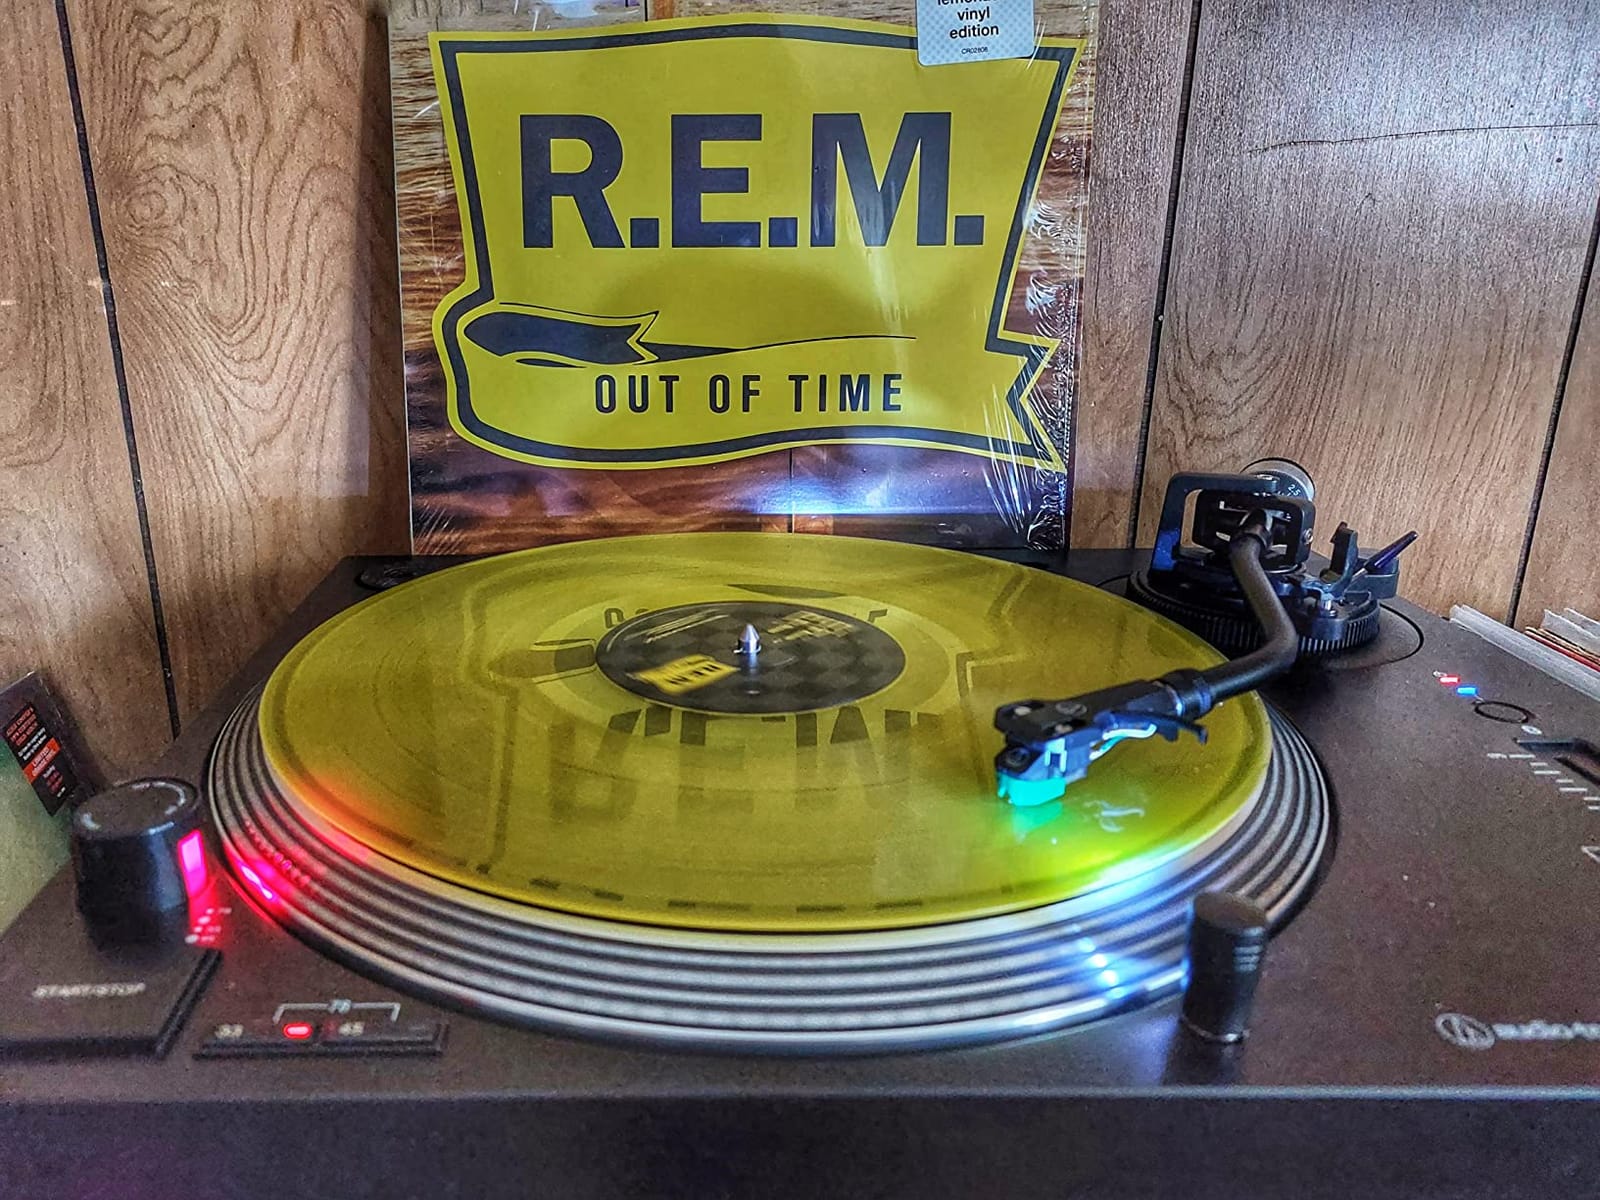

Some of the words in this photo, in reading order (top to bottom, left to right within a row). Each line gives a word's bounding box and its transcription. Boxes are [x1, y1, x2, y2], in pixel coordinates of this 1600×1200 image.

[957, 6, 990, 22] vinyl
[949, 24, 999, 39] edition
[520, 112, 985, 249] R.E.M.
[595, 375, 680, 413] OUT
[709, 375, 761, 413] OF
[788, 374, 903, 412] TIME
